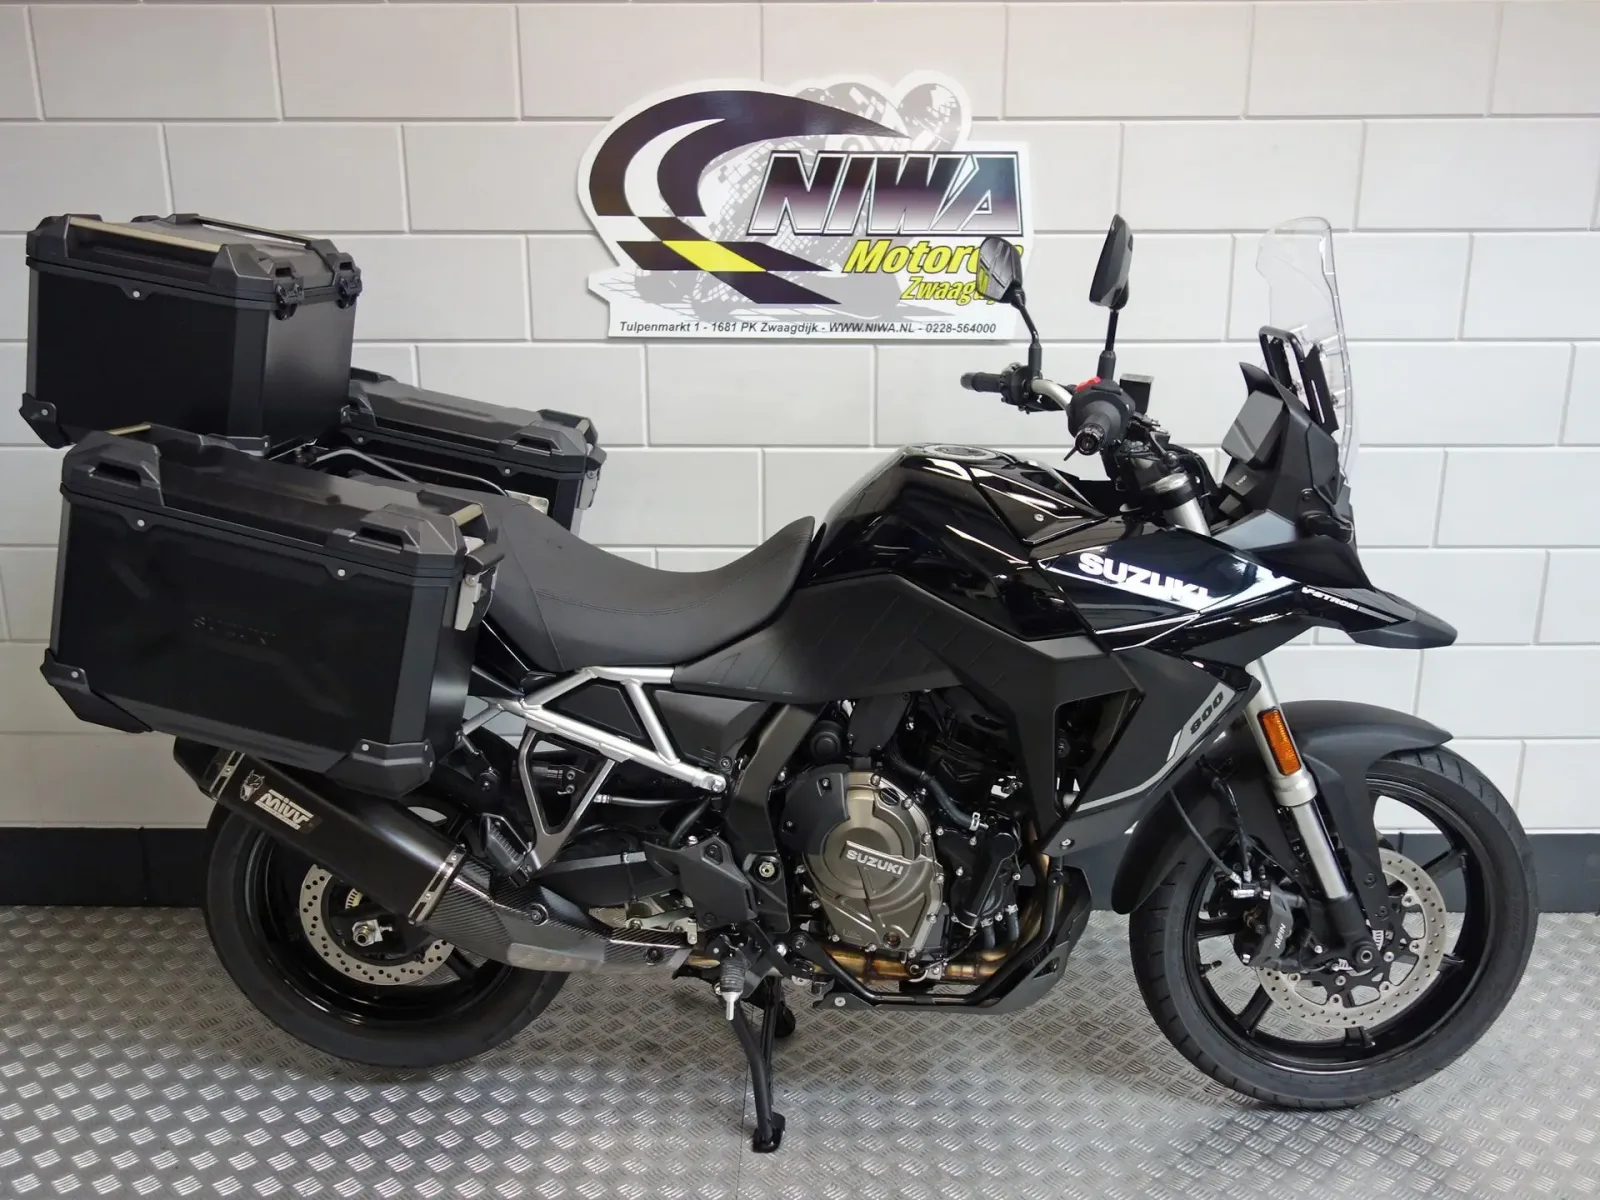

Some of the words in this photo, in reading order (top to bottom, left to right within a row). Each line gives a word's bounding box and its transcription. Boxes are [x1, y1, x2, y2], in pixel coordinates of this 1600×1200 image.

[746, 151, 1024, 236] NIWA
[842, 239, 1024, 274] Motor
[900, 276, 998, 306] Zwaag
[619, 321, 691, 334] Tulpenmarkt
[694, 322, 700, 333] 1
[711, 322, 737, 333] 1681
[740, 322, 758, 333] PK
[760, 322, 818, 336] Zwaagdijk
[828, 322, 915, 334] WWW.NIWA.NL
[925, 322, 997, 334] 0228-564000
[1077, 552, 1212, 606] SUZUKI
[1190, 691, 1224, 735] 800
[846, 849, 904, 875] SUZUKI
